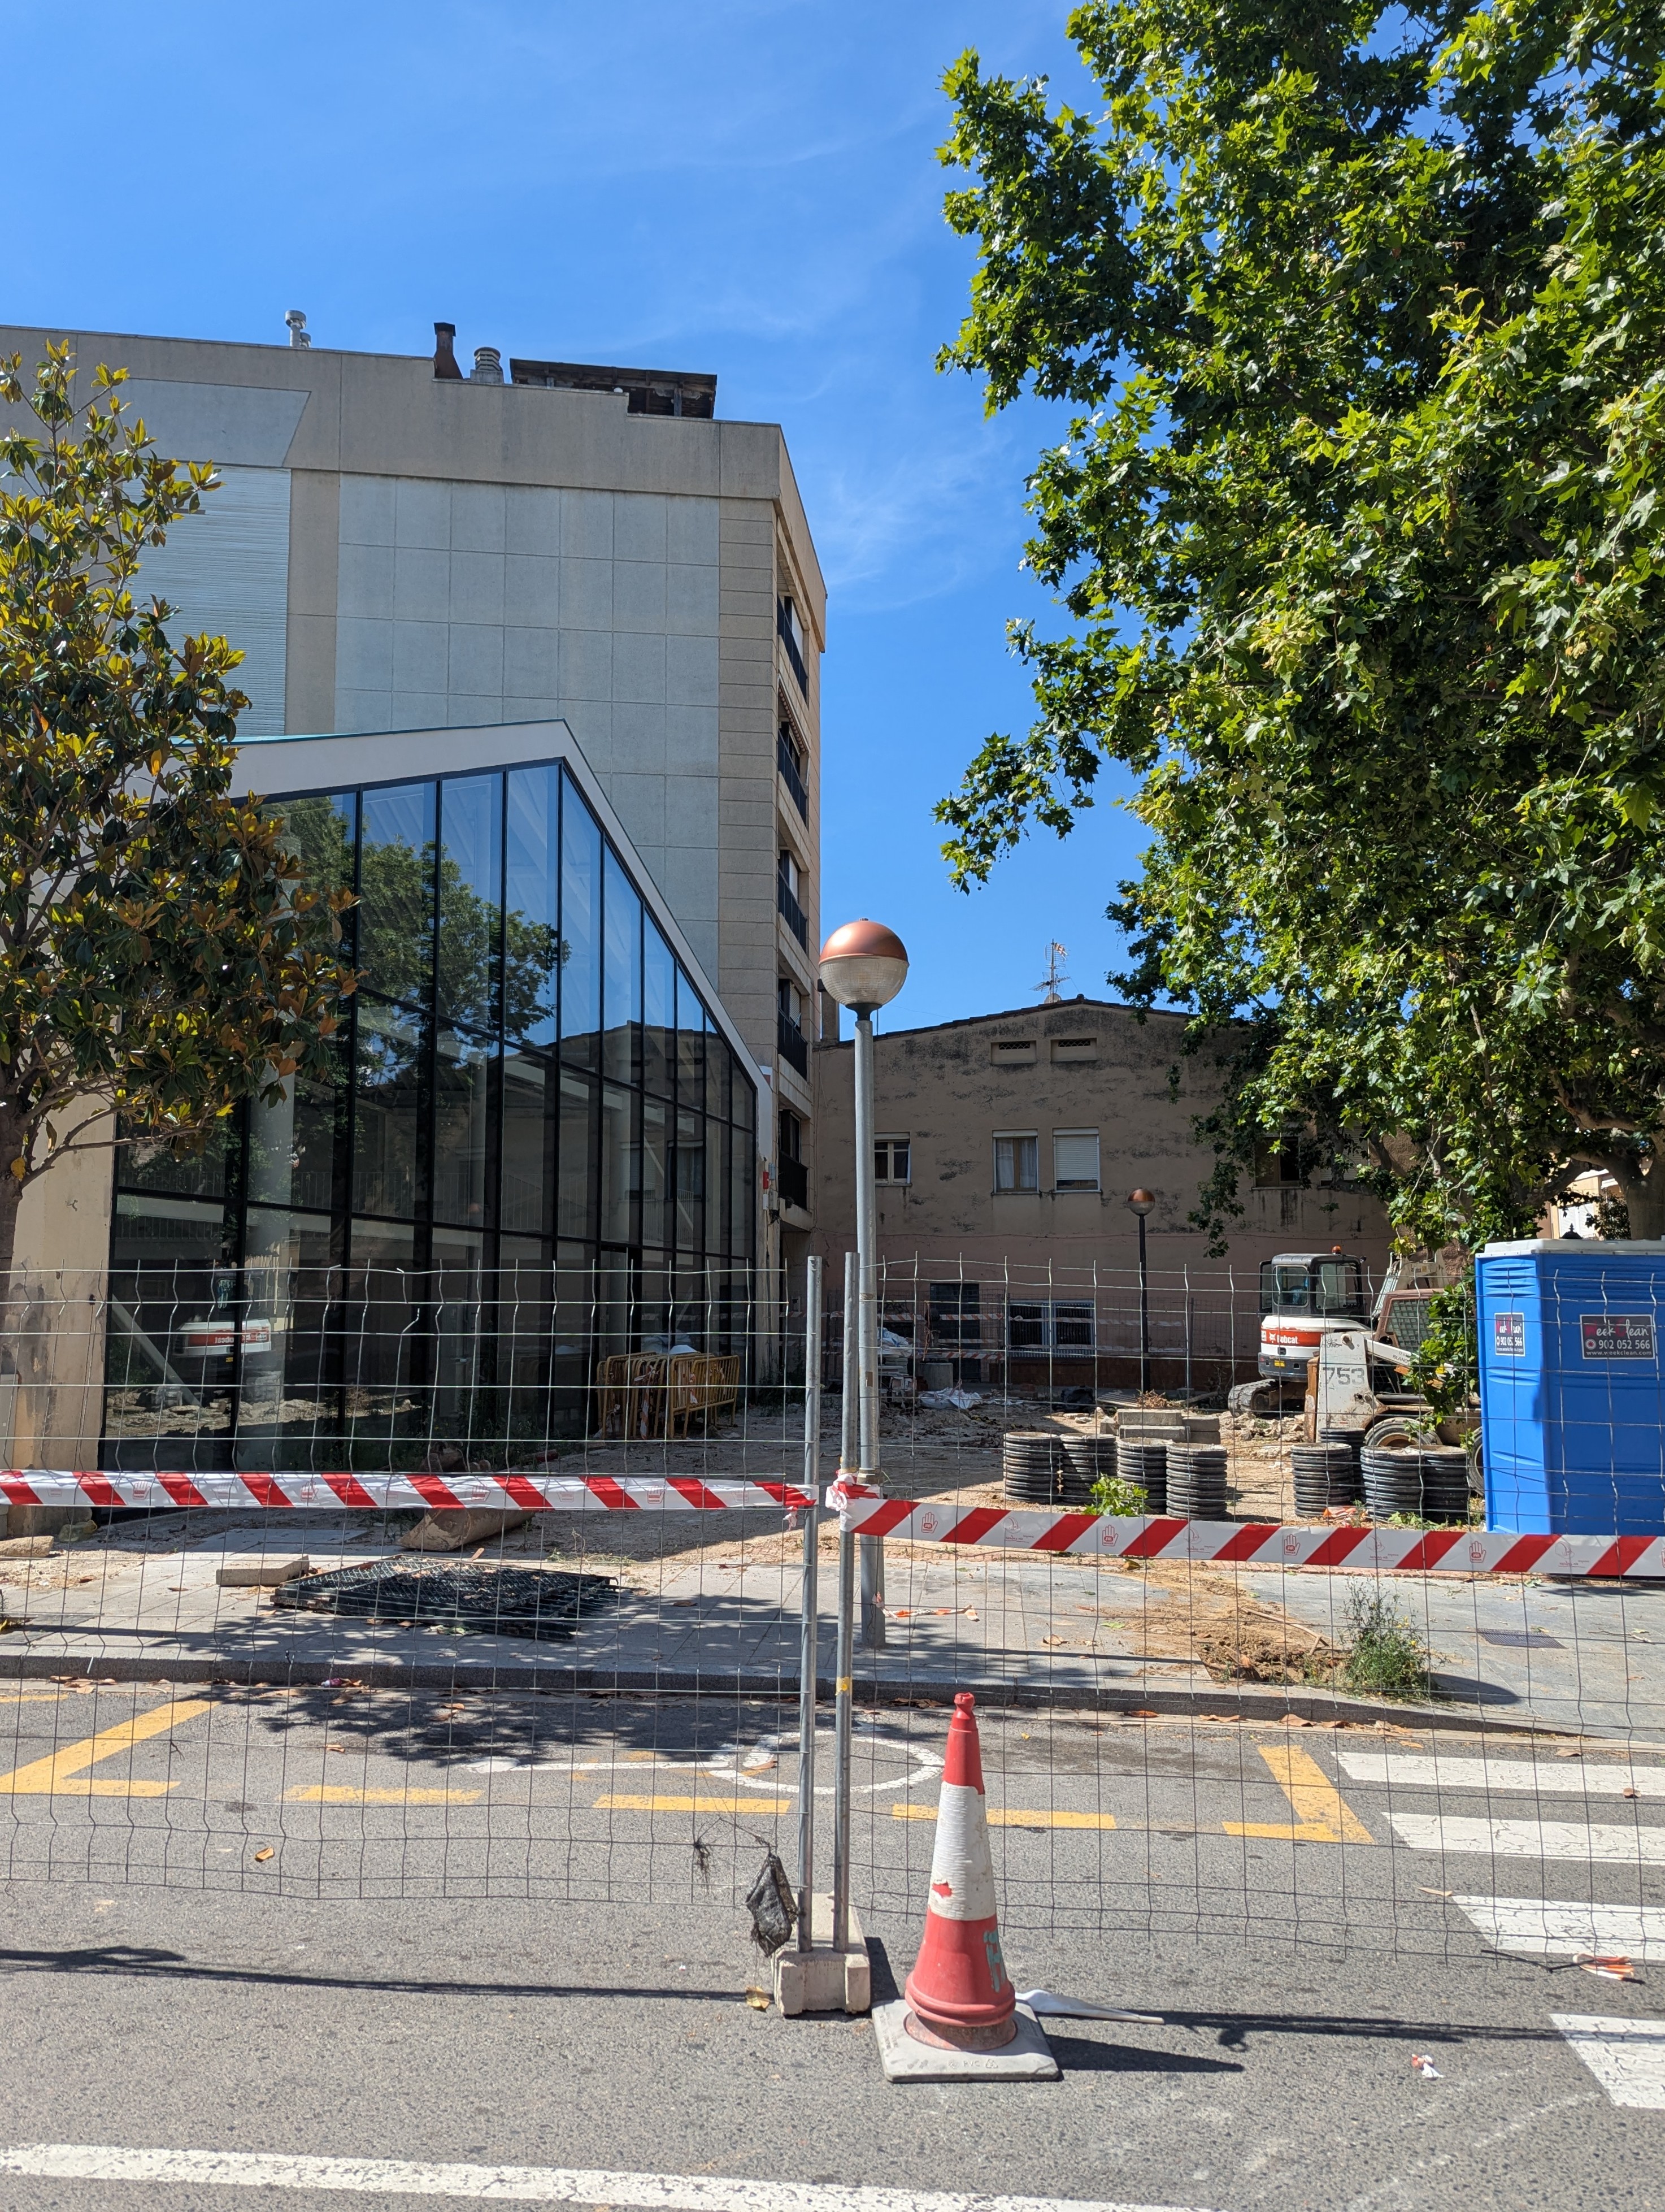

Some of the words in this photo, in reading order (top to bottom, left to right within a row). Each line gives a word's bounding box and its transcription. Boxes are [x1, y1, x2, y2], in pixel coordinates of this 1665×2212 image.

[1598, 1339, 1614, 1349] 902
[1617, 1339, 1632, 1350] 052
[1635, 1339, 1650, 1350] 566
[1323, 1367, 1364, 1385] 753
